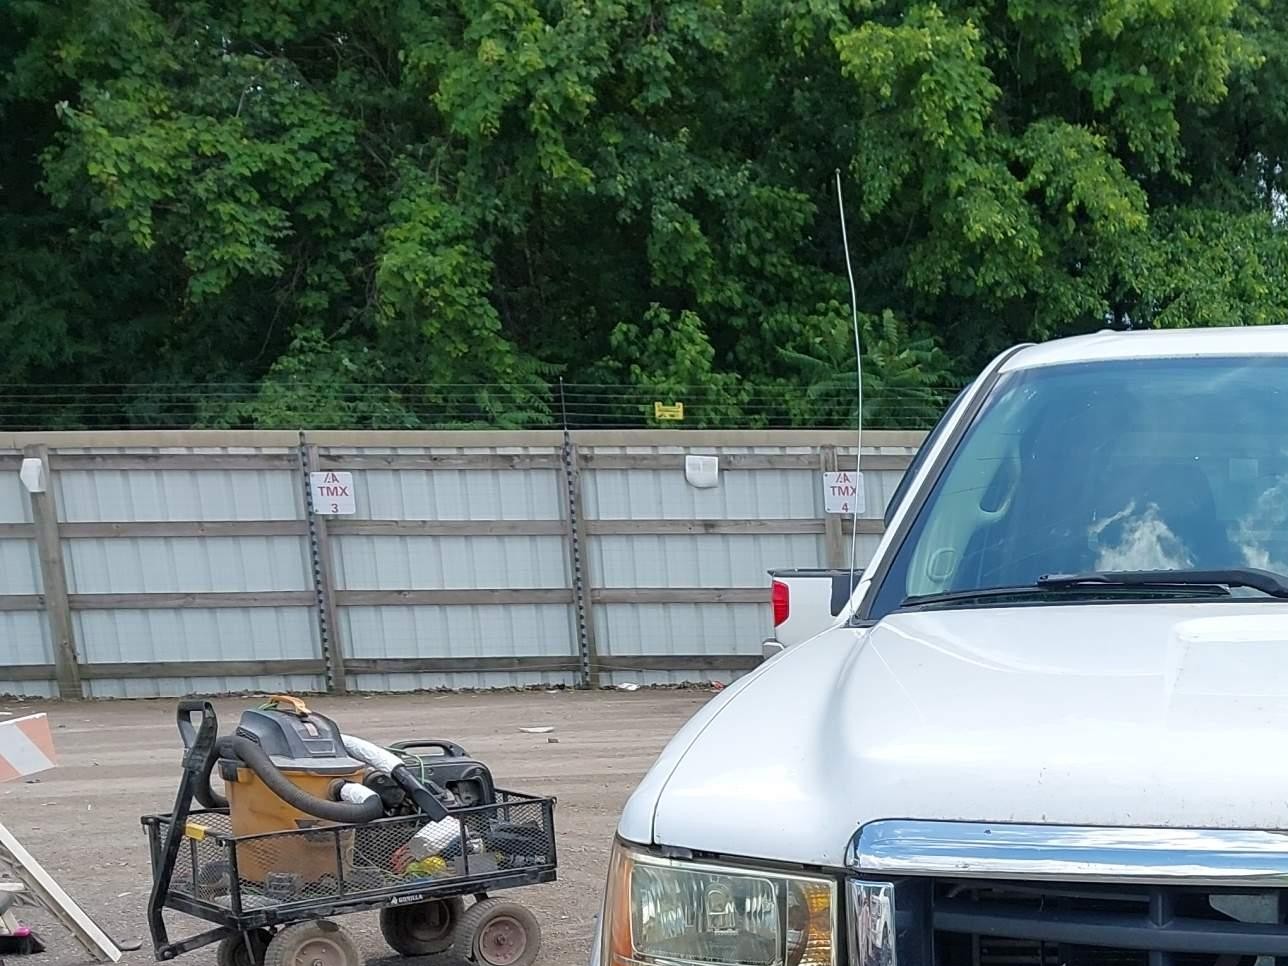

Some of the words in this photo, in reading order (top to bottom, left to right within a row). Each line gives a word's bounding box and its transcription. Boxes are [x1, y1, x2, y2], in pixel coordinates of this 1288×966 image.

[317, 486, 349, 496] TMX
[830, 485, 857, 496] TMX
[331, 503, 339, 513] 3
[841, 502, 849, 512] 4
